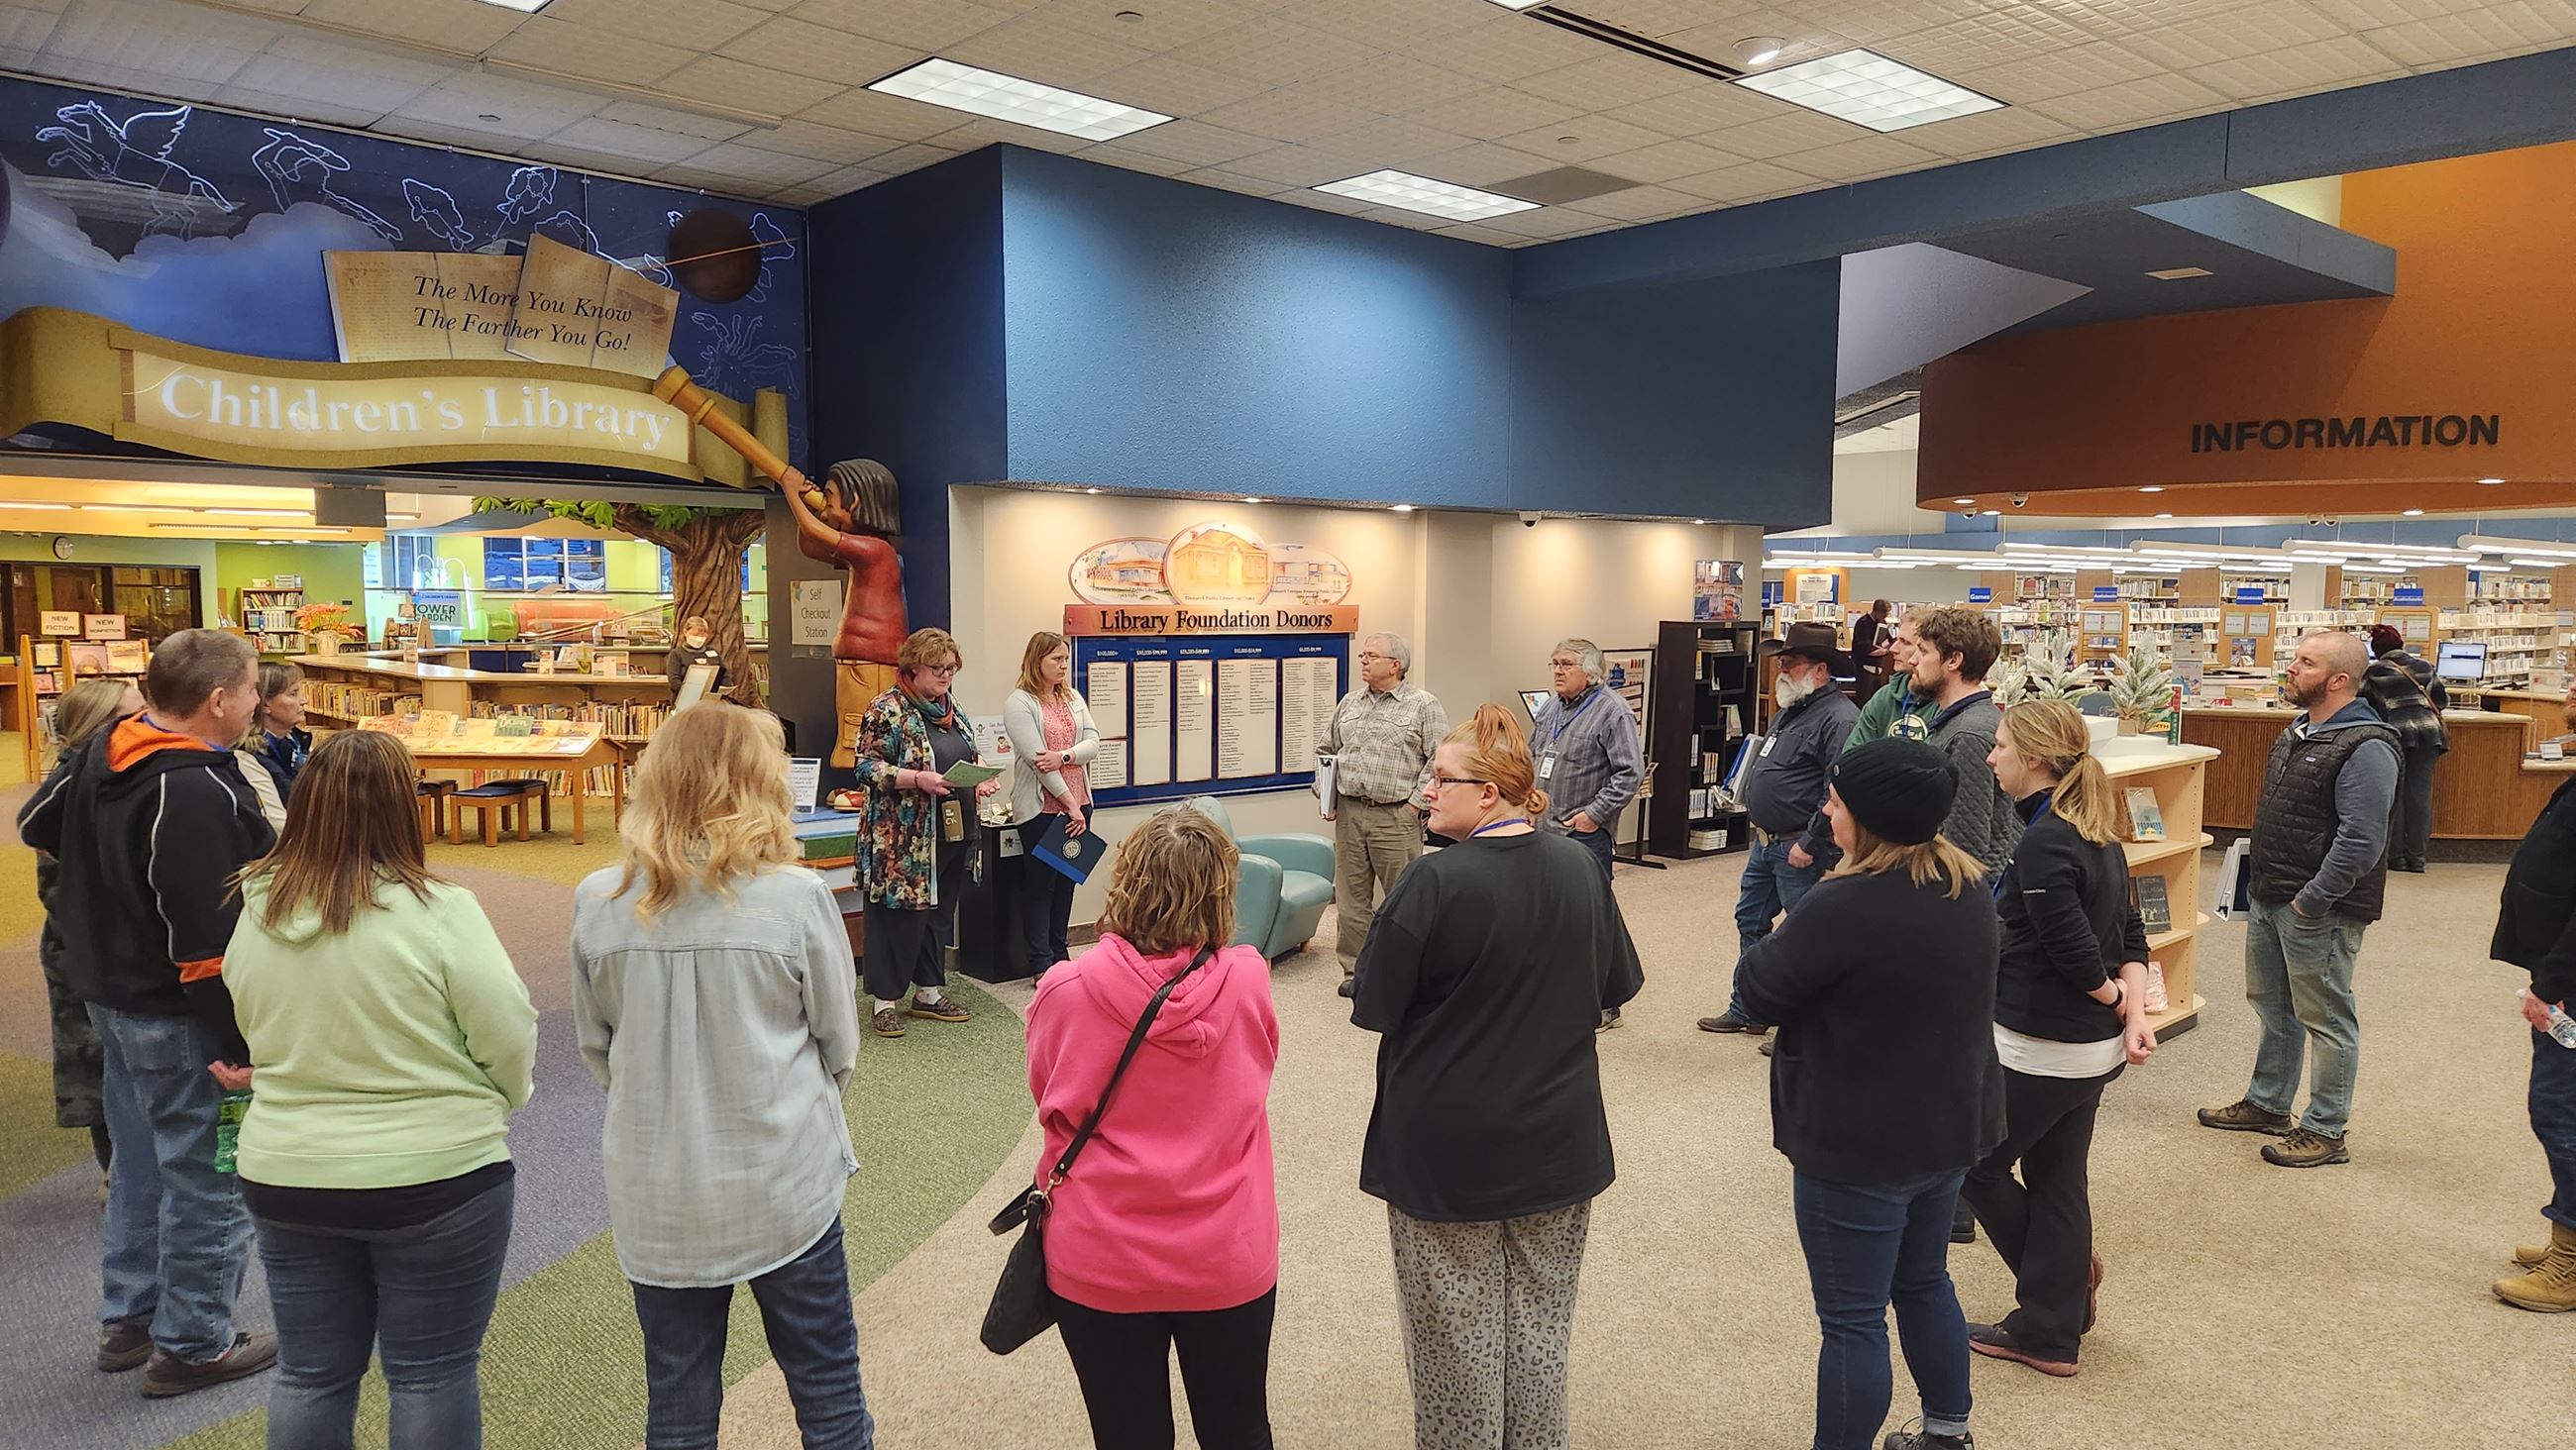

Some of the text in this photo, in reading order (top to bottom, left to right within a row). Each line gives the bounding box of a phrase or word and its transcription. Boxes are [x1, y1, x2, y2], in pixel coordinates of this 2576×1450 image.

[414, 275, 632, 323] The More You Know
[414, 307, 632, 351] The Farther You Go!
[160, 372, 672, 452] Children's Library
[2192, 414, 2500, 453] INFORMATION
[809, 588, 822, 601] Self
[801, 607, 831, 619] Checkout
[1100, 609, 1333, 633] Library Foundation Donors
[805, 626, 827, 638] Station
